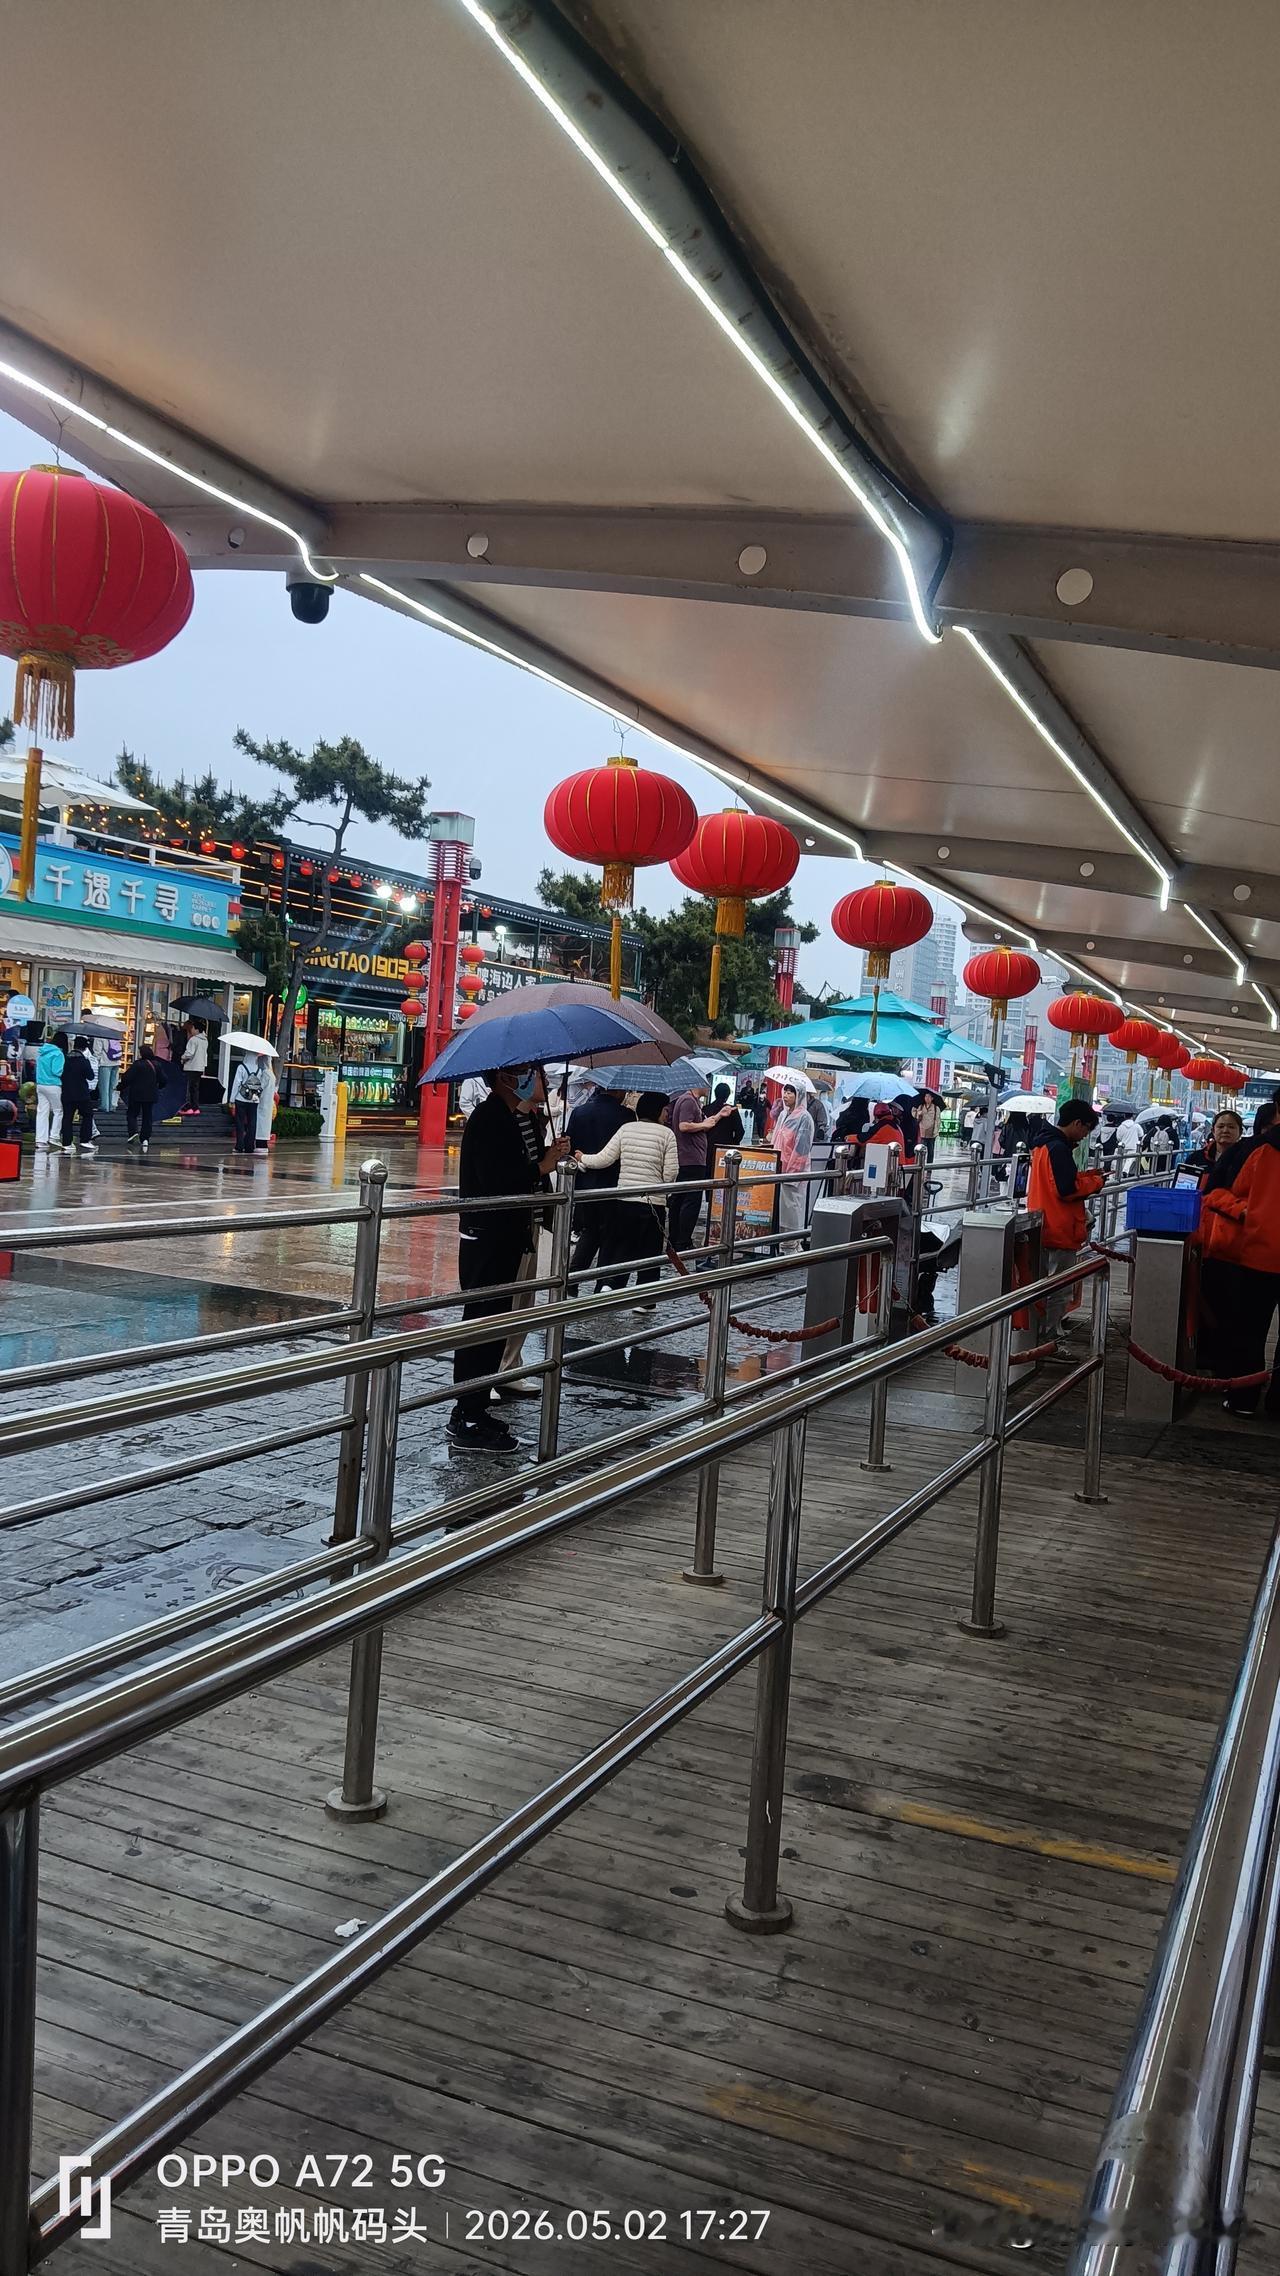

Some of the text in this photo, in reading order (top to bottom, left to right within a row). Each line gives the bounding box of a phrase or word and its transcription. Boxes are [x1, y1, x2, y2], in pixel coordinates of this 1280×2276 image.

[44, 864, 180, 922] 千遇千寻
[371, 954, 410, 981] 1903
[464, 965, 537, 990] 啤海边人家
[477, 988, 503, 1001] 青岛
